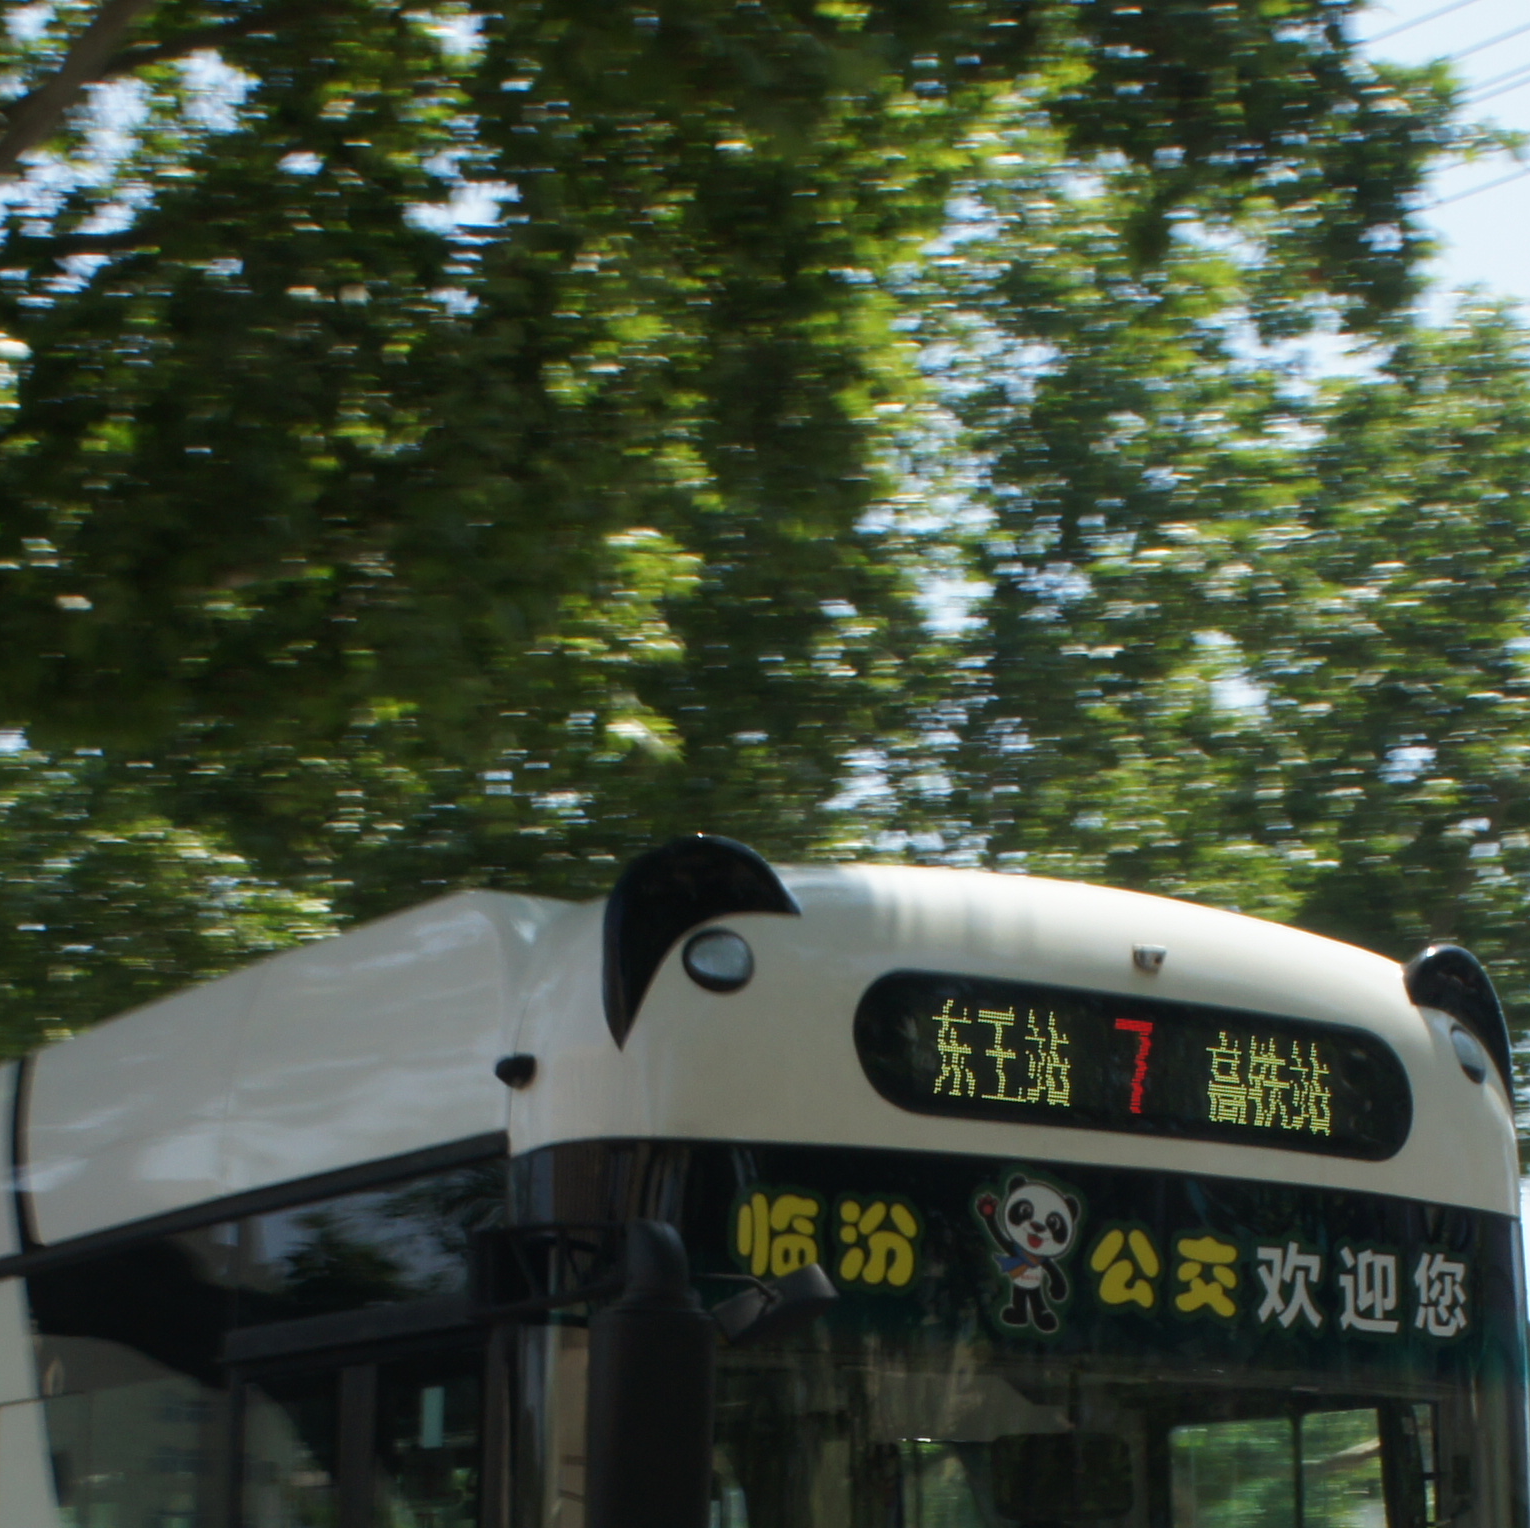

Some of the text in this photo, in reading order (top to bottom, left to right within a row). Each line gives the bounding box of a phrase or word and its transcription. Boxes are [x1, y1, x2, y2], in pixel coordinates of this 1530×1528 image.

[1114, 1017, 1154, 1114] 7
[1205, 1030, 1331, 1137] 高铁站
[737, 1191, 918, 1287] 临汾
